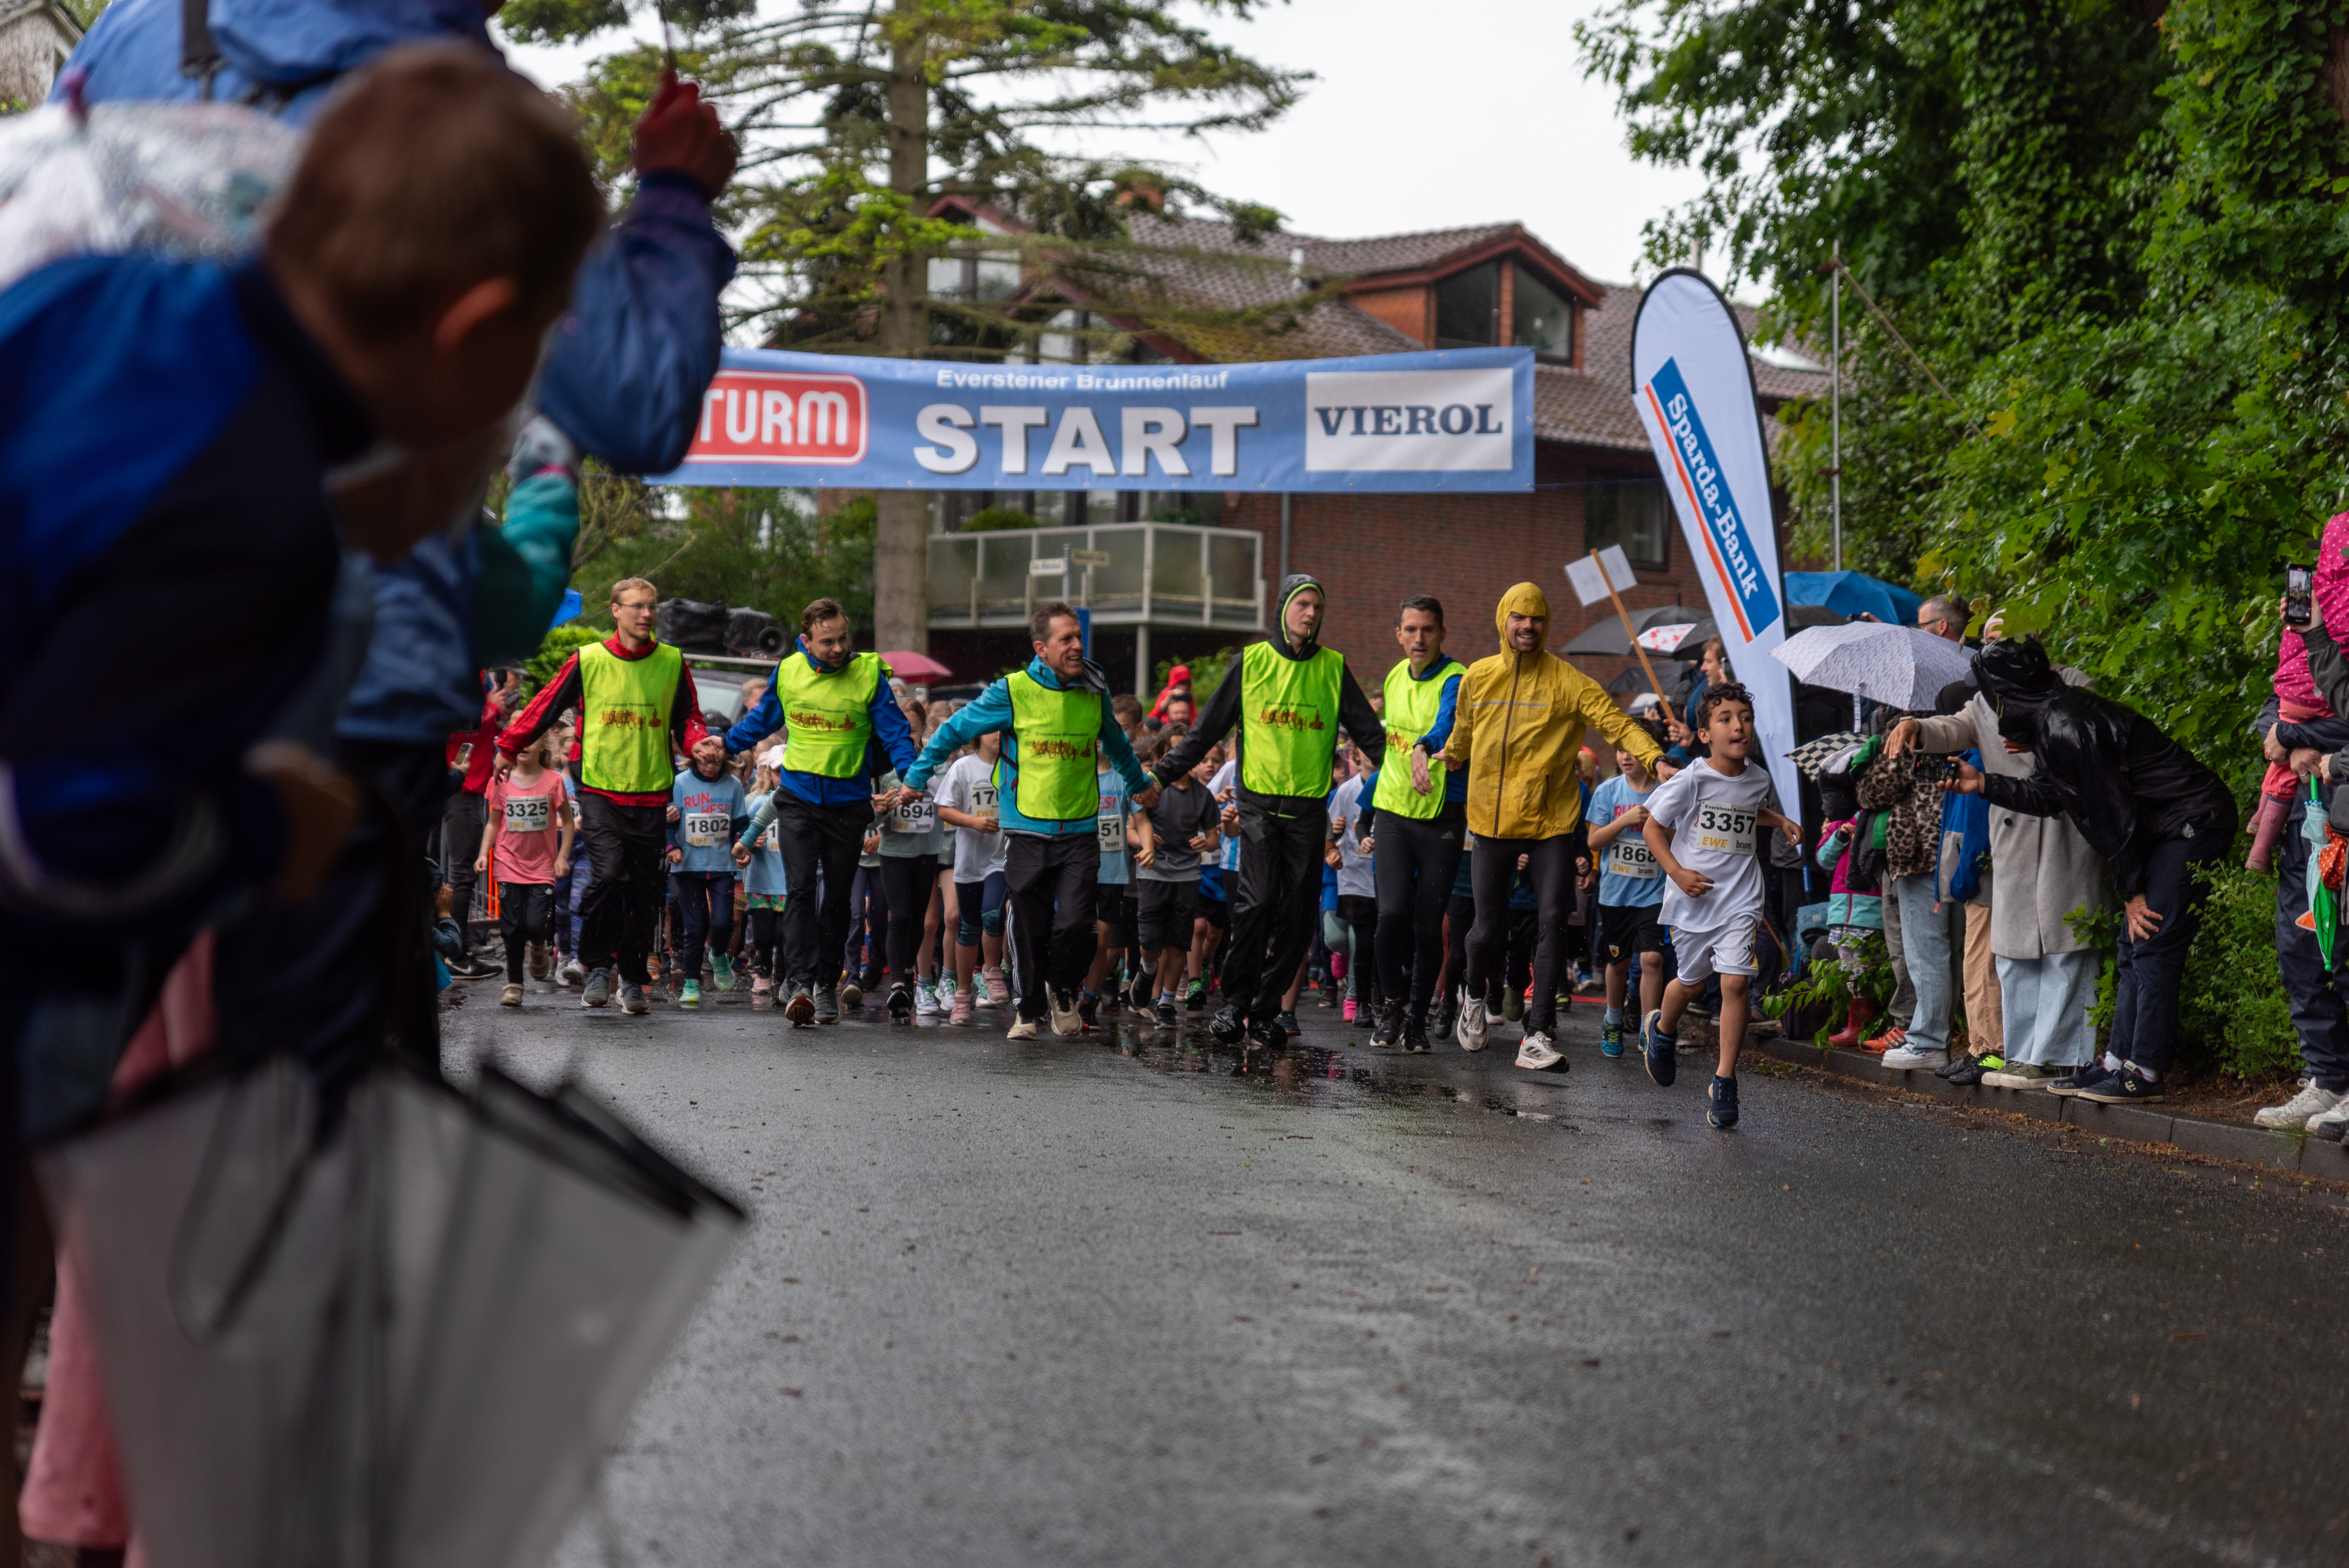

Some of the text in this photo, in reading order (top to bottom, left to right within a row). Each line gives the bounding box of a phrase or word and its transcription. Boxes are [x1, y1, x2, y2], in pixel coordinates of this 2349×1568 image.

[936, 369, 1229, 390] Everstener Brunnenlauf
[1314, 403, 1503, 436] VIEROL
[913, 403, 1261, 477] START
[1667, 393, 1759, 600] Sparda-Bank
[506, 801, 548, 817] 3325
[684, 792, 710, 810] RUN
[893, 804, 933, 818] 1694
[688, 818, 729, 833] 1802
[1097, 822, 1120, 837] 51
[1700, 811, 1756, 835] 3357
[1702, 836, 1728, 848] EWE
[1736, 840, 1752, 850] bruns
[1612, 844, 1657, 863] 1868
[1612, 863, 1631, 873] EWE
